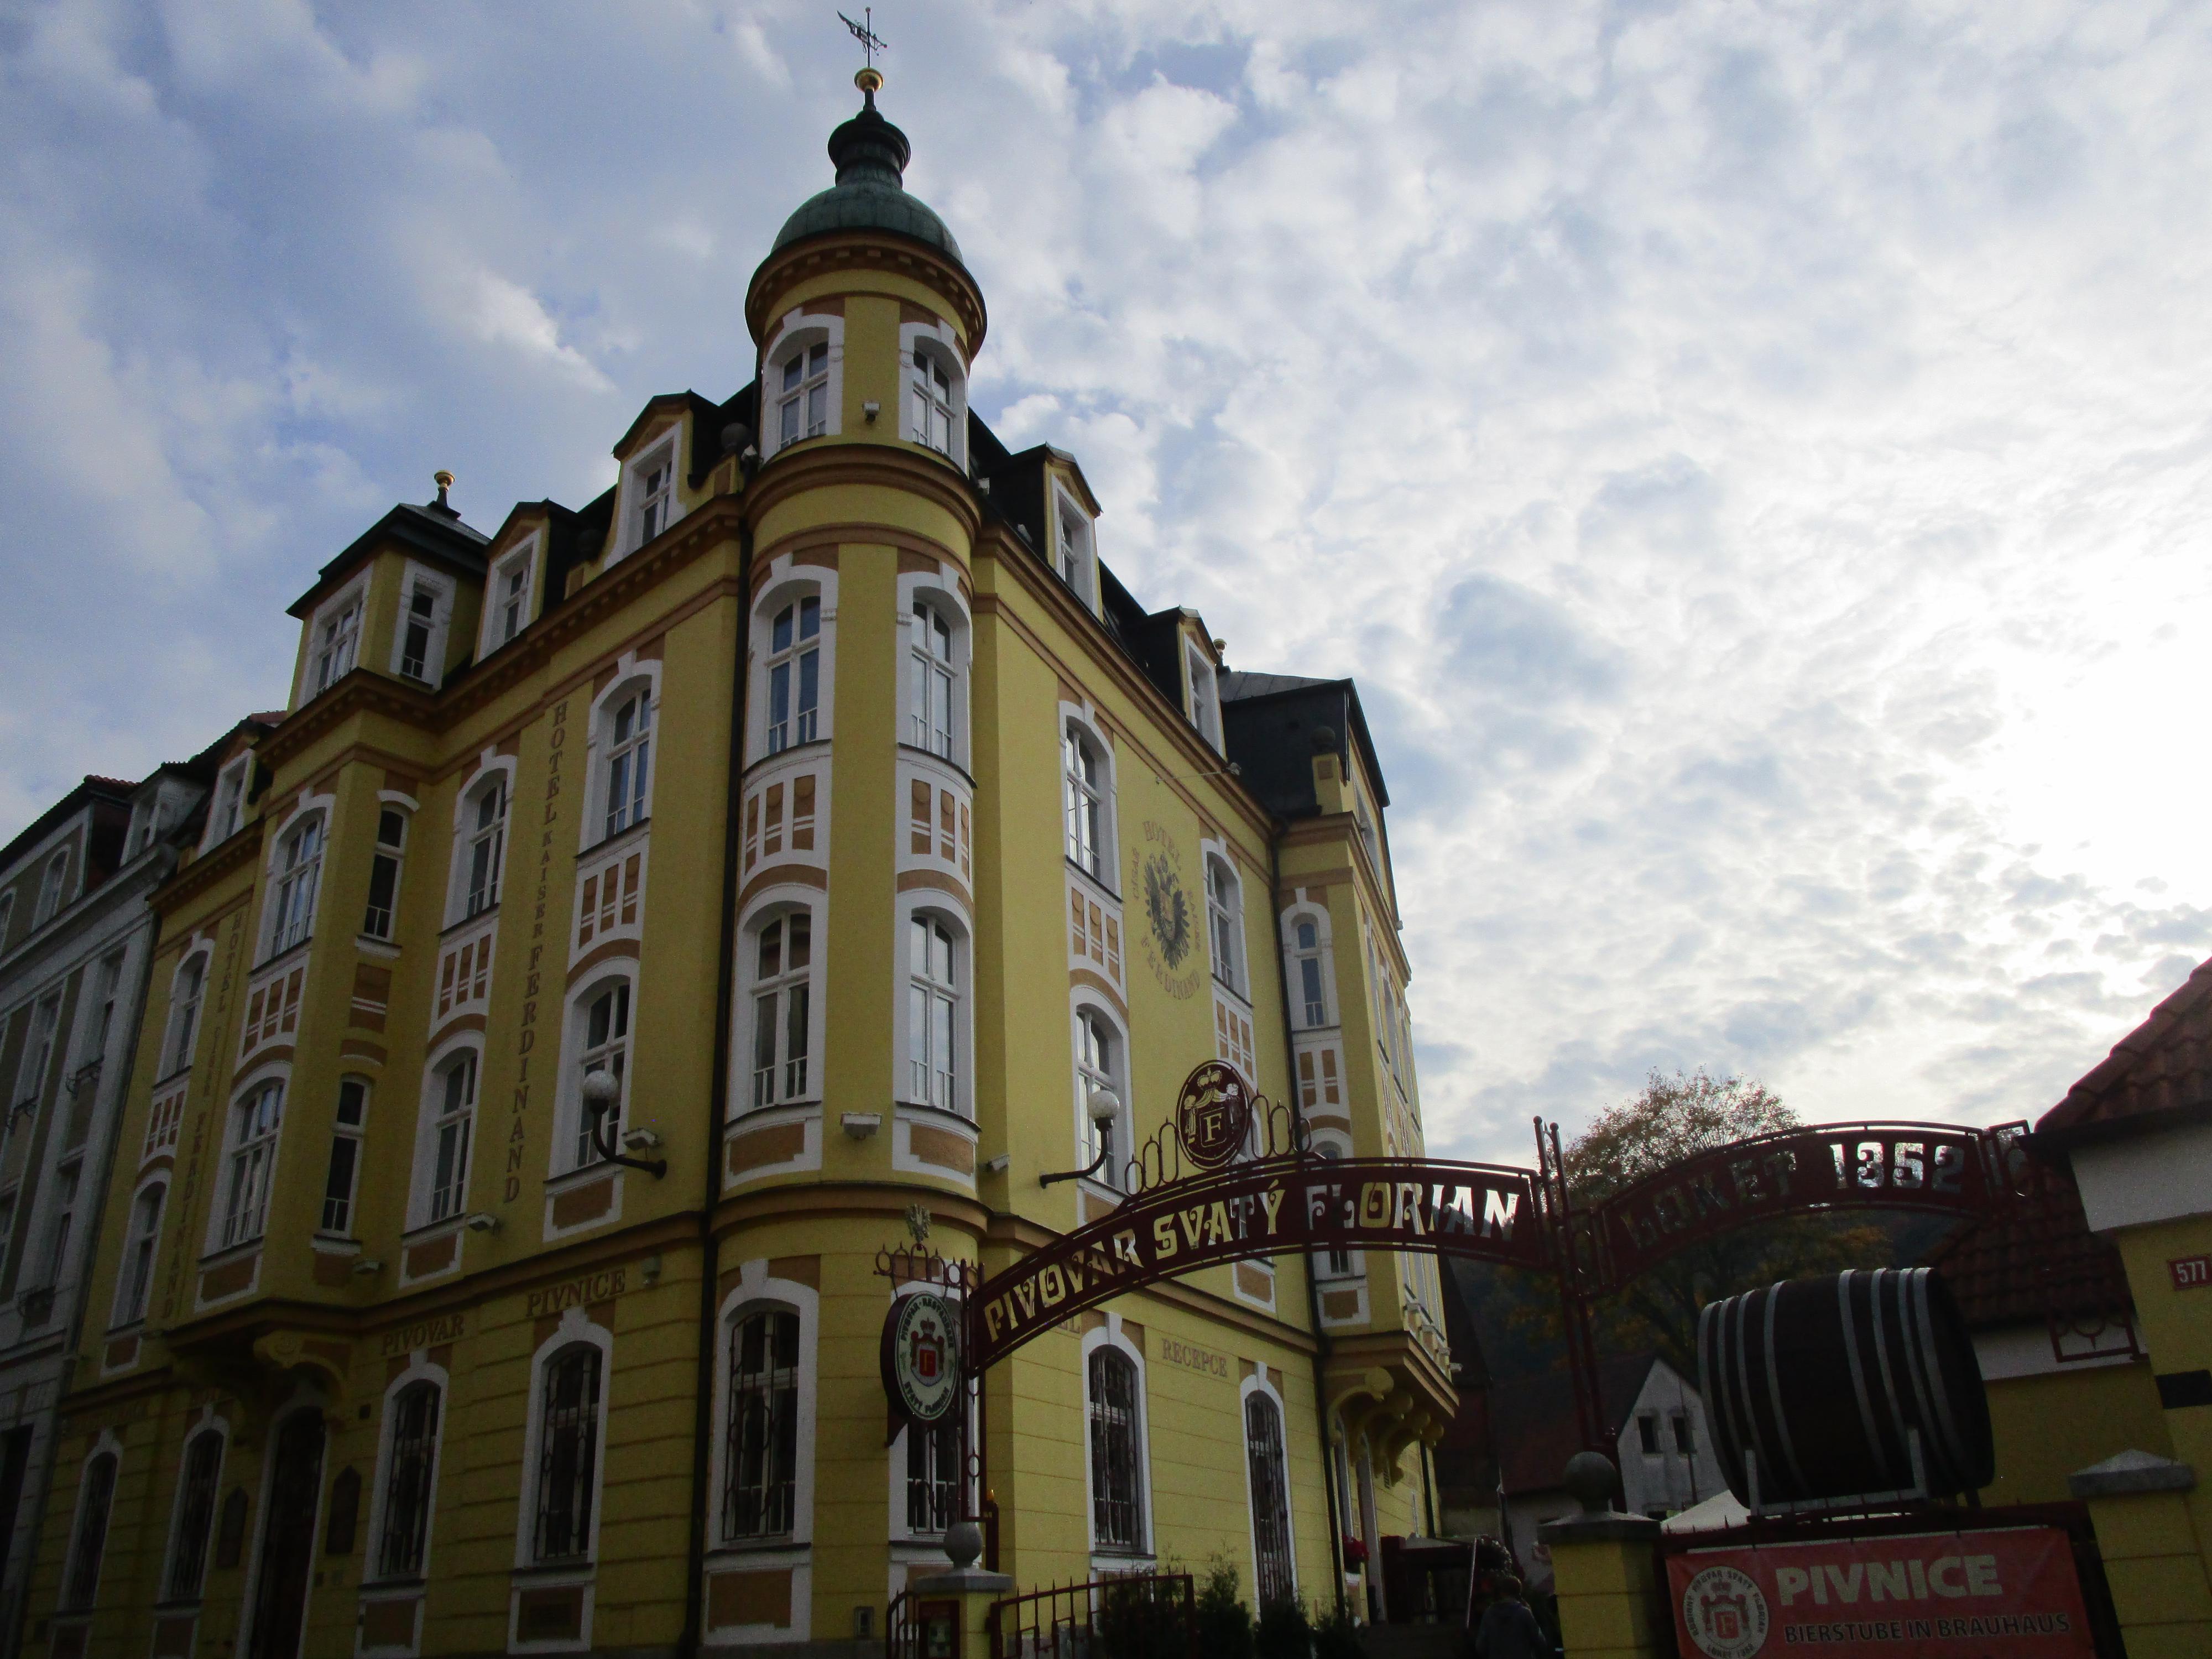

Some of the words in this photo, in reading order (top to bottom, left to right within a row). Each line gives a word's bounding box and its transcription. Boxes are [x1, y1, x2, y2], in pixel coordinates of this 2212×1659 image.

[544, 701, 568, 825] HOTEL
[533, 831, 552, 939] KAISER
[504, 945, 542, 1204] FERDINAND
[1203, 1113, 1223, 1143] F
[1620, 1150, 1797, 1250] LOKET
[1829, 1141, 1965, 1193] 1352
[982, 1228, 1145, 1344] PIVOVAR
[1154, 1178, 1286, 1260] SVATÝ
[1305, 1182, 1521, 1241] FLORIAN
[2176, 1260, 2207, 1283] 577
[526, 1268, 627, 1317] PIVNICE
[381, 1314, 465, 1357] PIVOVAR
[1162, 1337, 1228, 1378] RECEPCE
[1776, 1553, 2002, 1607] PIVNICE
[1783, 1619, 1902, 1645] BIERSTUBE
[1906, 1618, 1932, 1639] IN
[1936, 1611, 2071, 1637] BRAUHAUS
